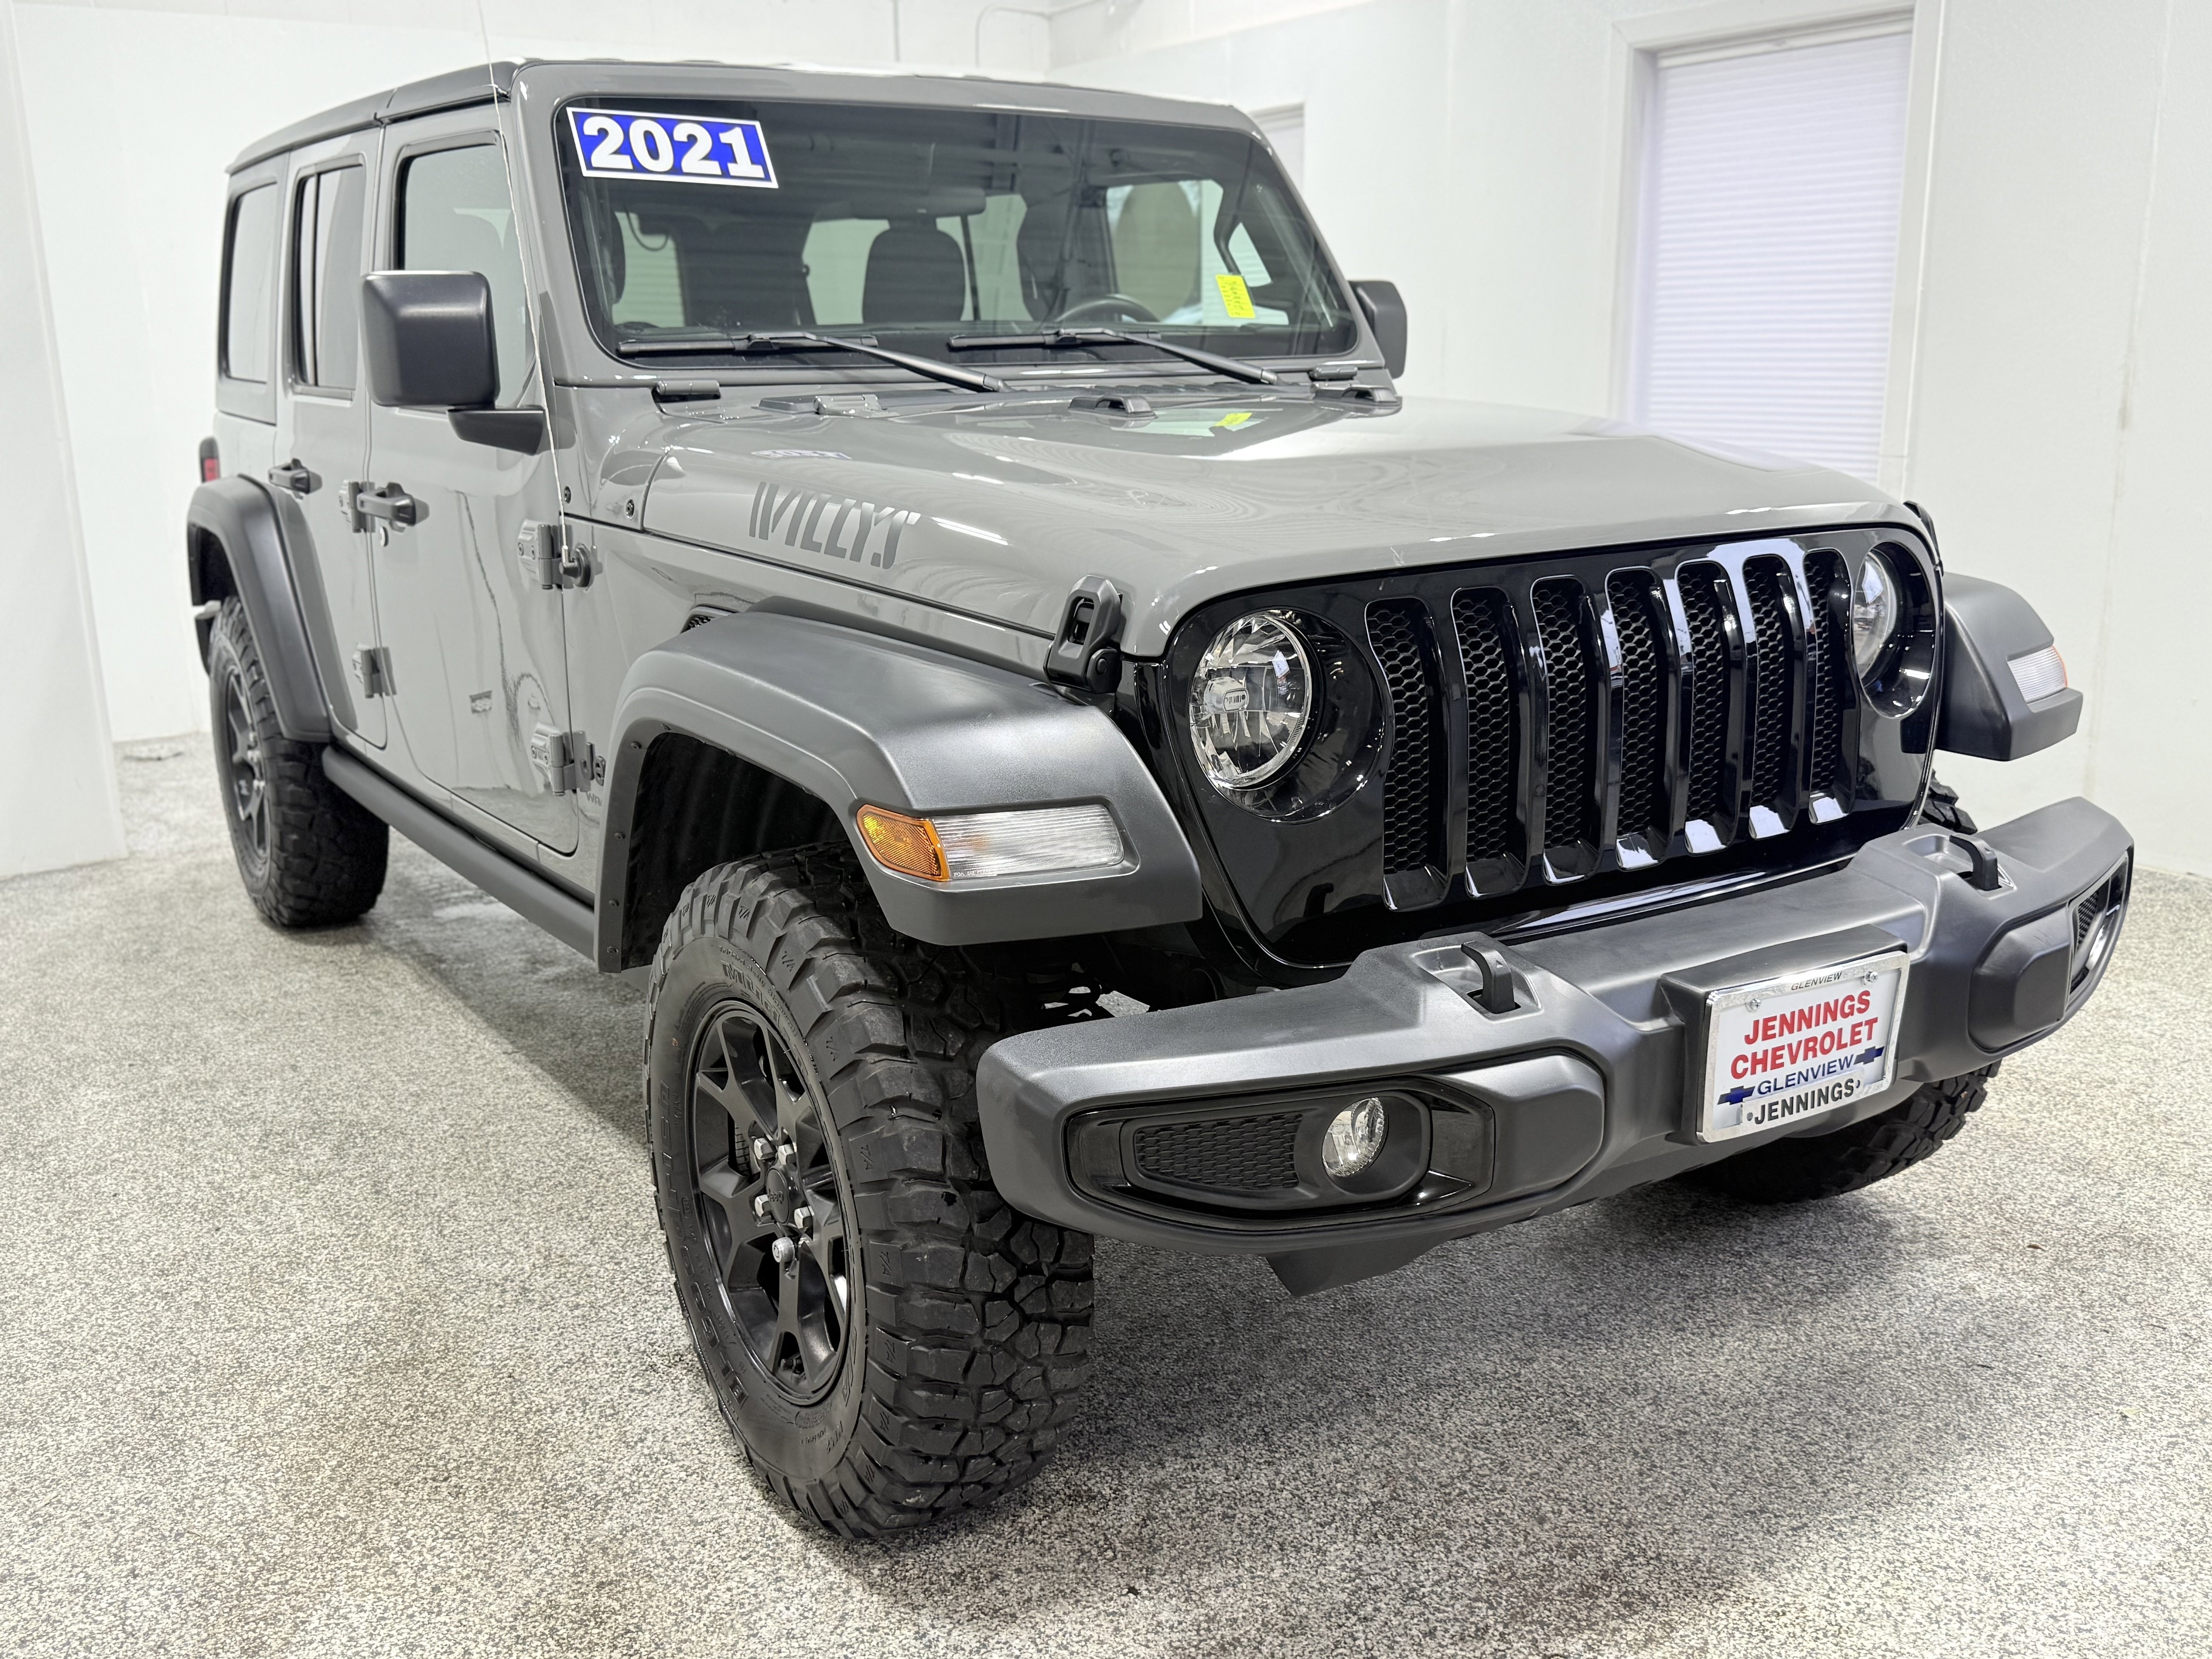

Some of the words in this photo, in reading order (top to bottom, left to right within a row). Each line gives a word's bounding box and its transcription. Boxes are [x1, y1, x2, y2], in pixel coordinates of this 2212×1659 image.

[583, 116, 765, 178] 2021
[749, 481, 921, 569] WILLYS
[580, 742, 606, 787] Je
[1791, 972, 1842, 991] GLENVIEW
[1744, 990, 1871, 1045] JENNINGS
[1730, 1017, 1879, 1079] CHEVROLET
[1757, 1053, 1854, 1095] GLENVIEW
[1754, 1078, 1854, 1125] JENNINGS
